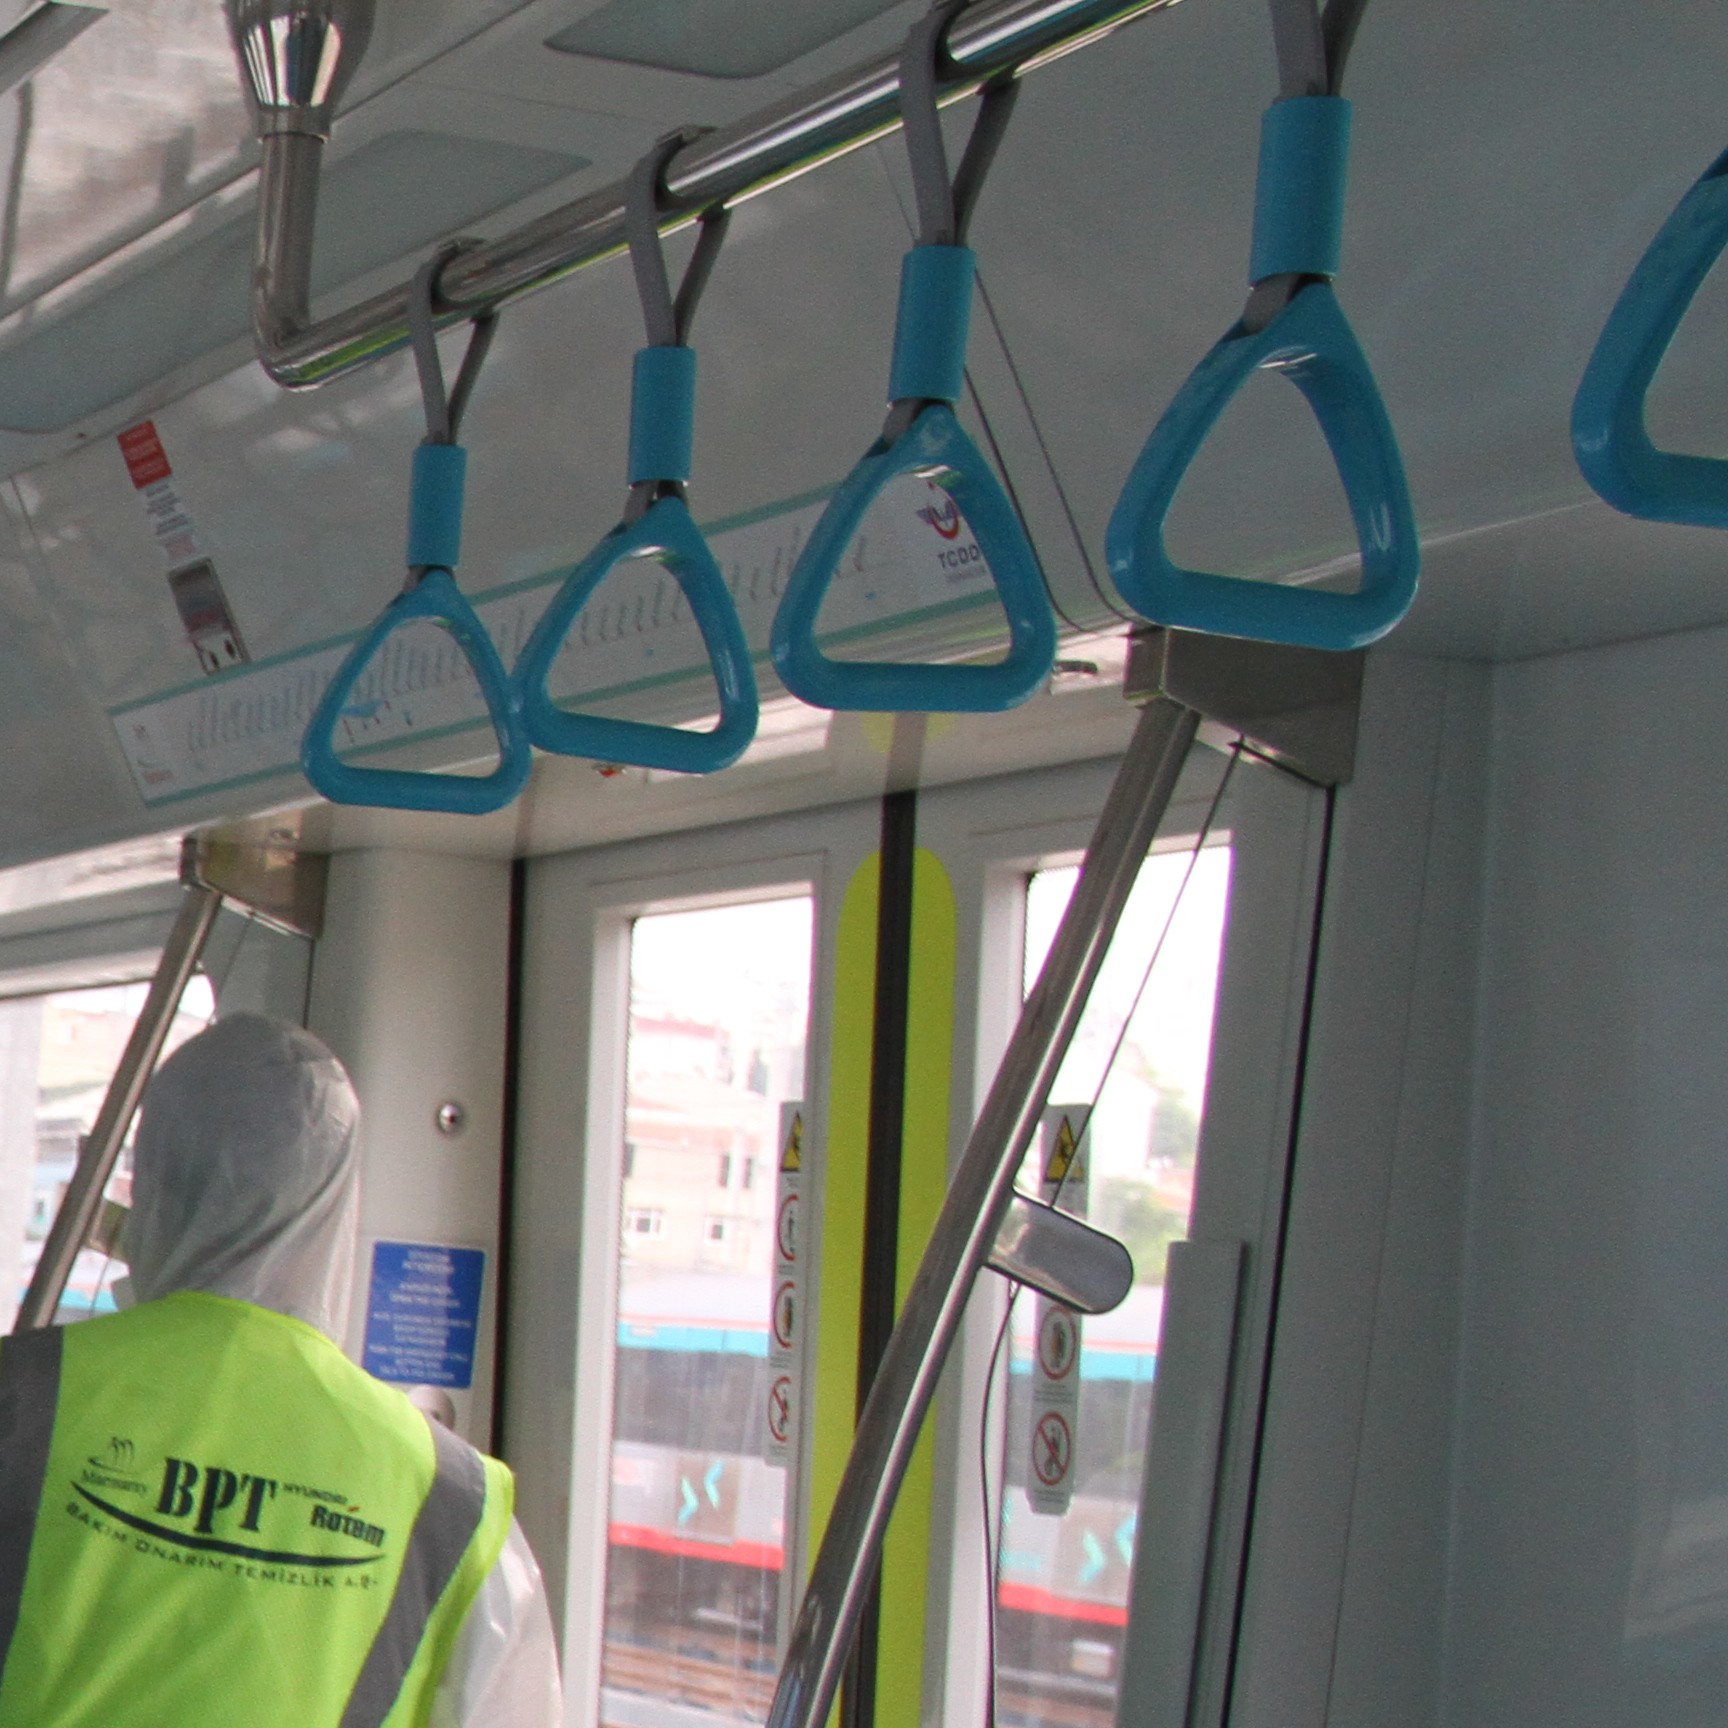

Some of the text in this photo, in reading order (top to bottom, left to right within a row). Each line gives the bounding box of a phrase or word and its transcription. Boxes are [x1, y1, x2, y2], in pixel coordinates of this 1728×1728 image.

[155, 1456, 277, 1534] BPT
[65, 1501, 127, 1541] BAKIM
[135, 1539, 223, 1570] ONARIM
